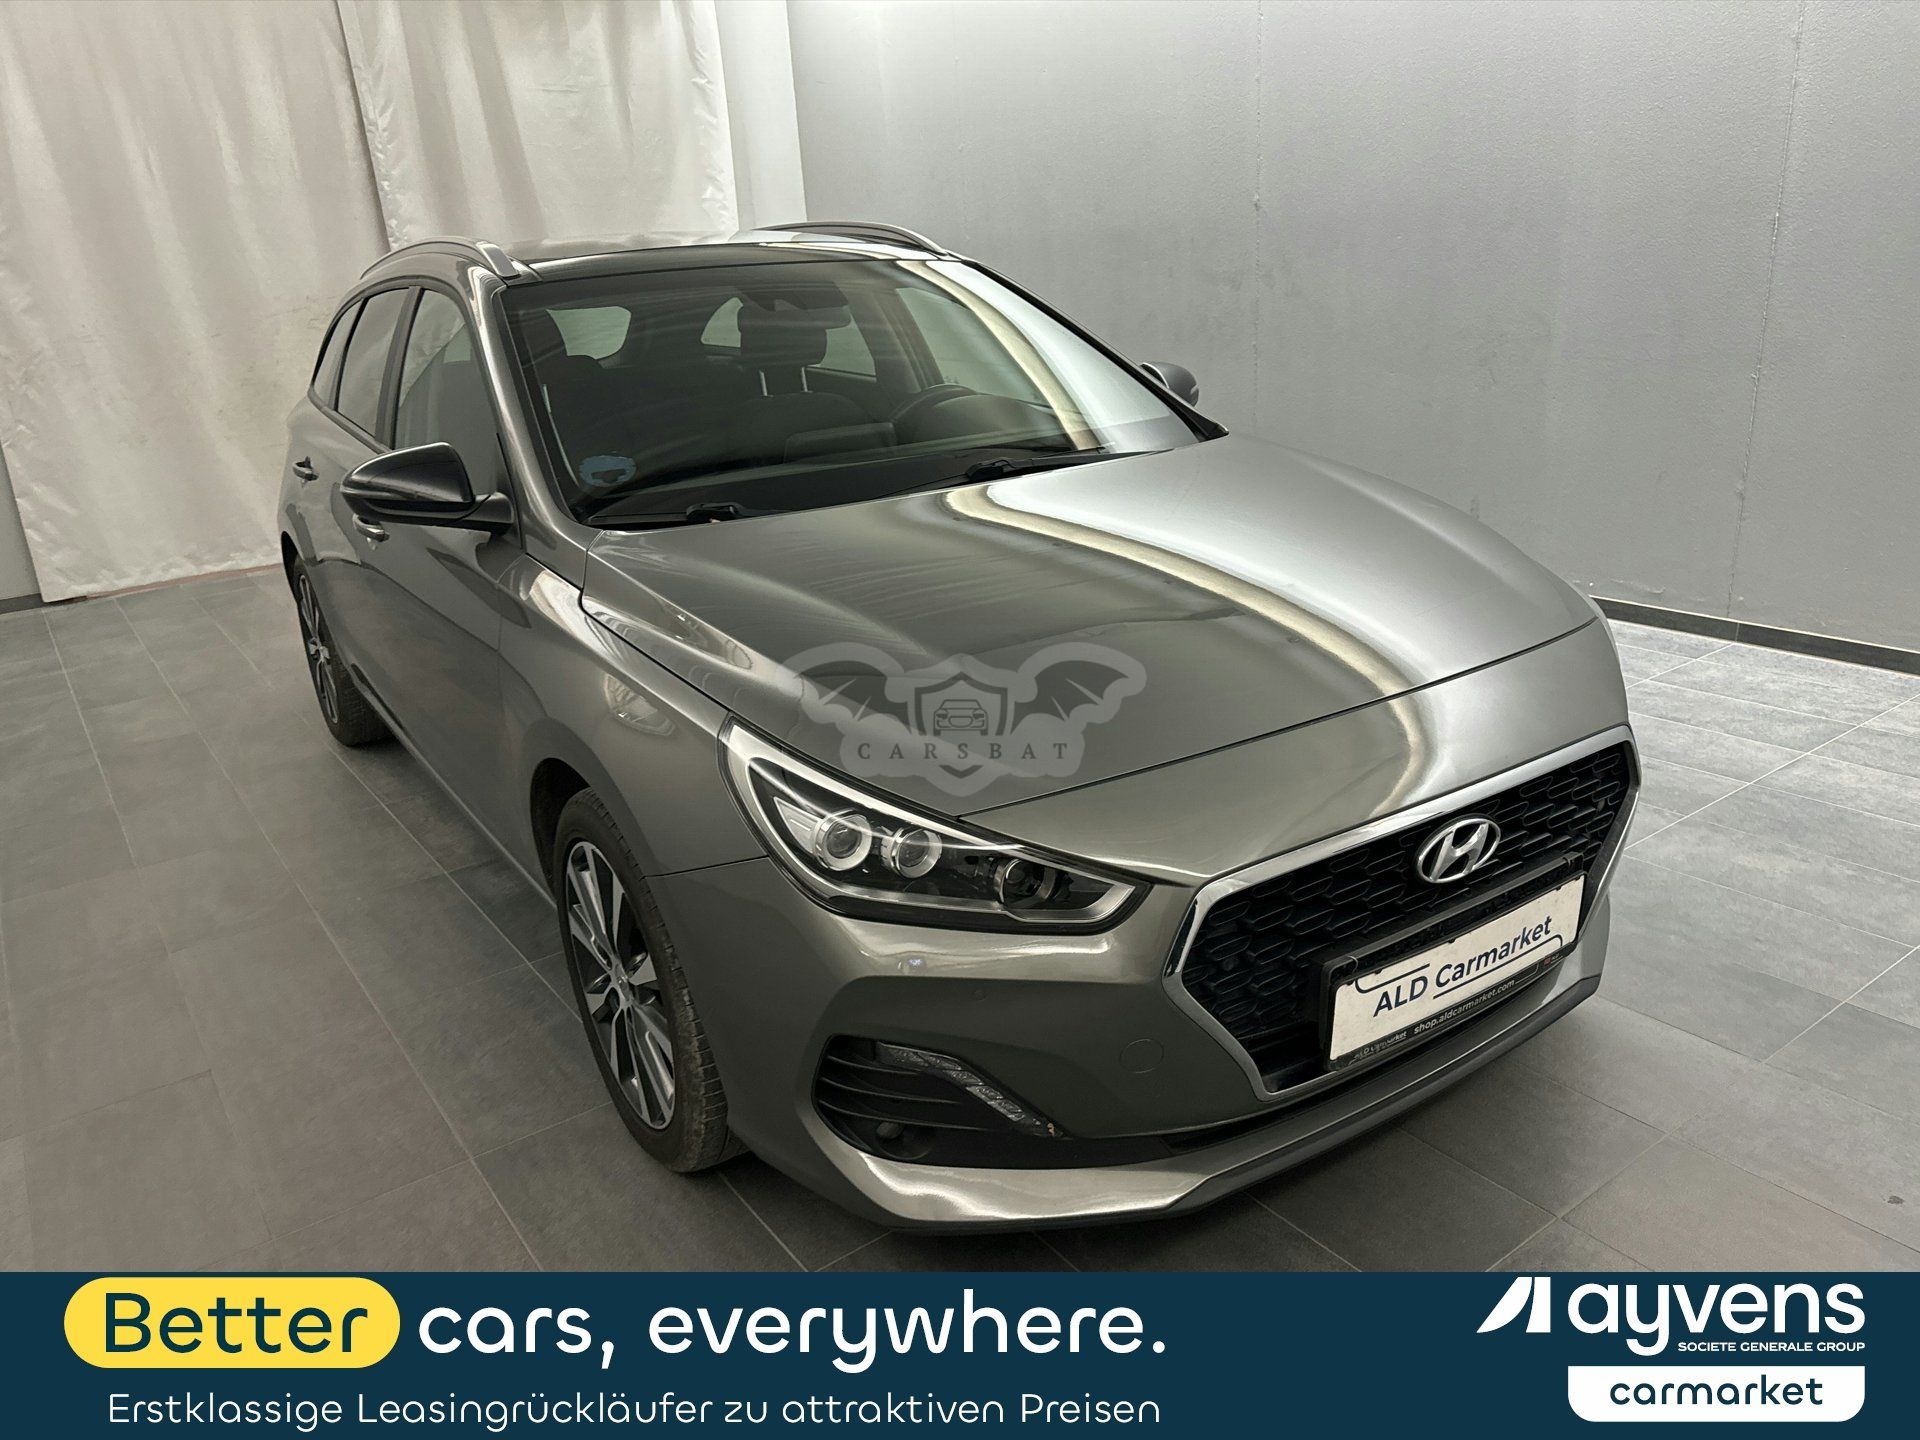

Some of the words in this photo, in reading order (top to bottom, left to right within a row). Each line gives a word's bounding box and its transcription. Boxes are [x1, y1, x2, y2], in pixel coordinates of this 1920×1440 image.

[1373, 975, 1428, 1018] ALD
[1435, 916, 1553, 988] Carmarket
[1413, 979, 1516, 1035] shop.aldcarmarket.com
